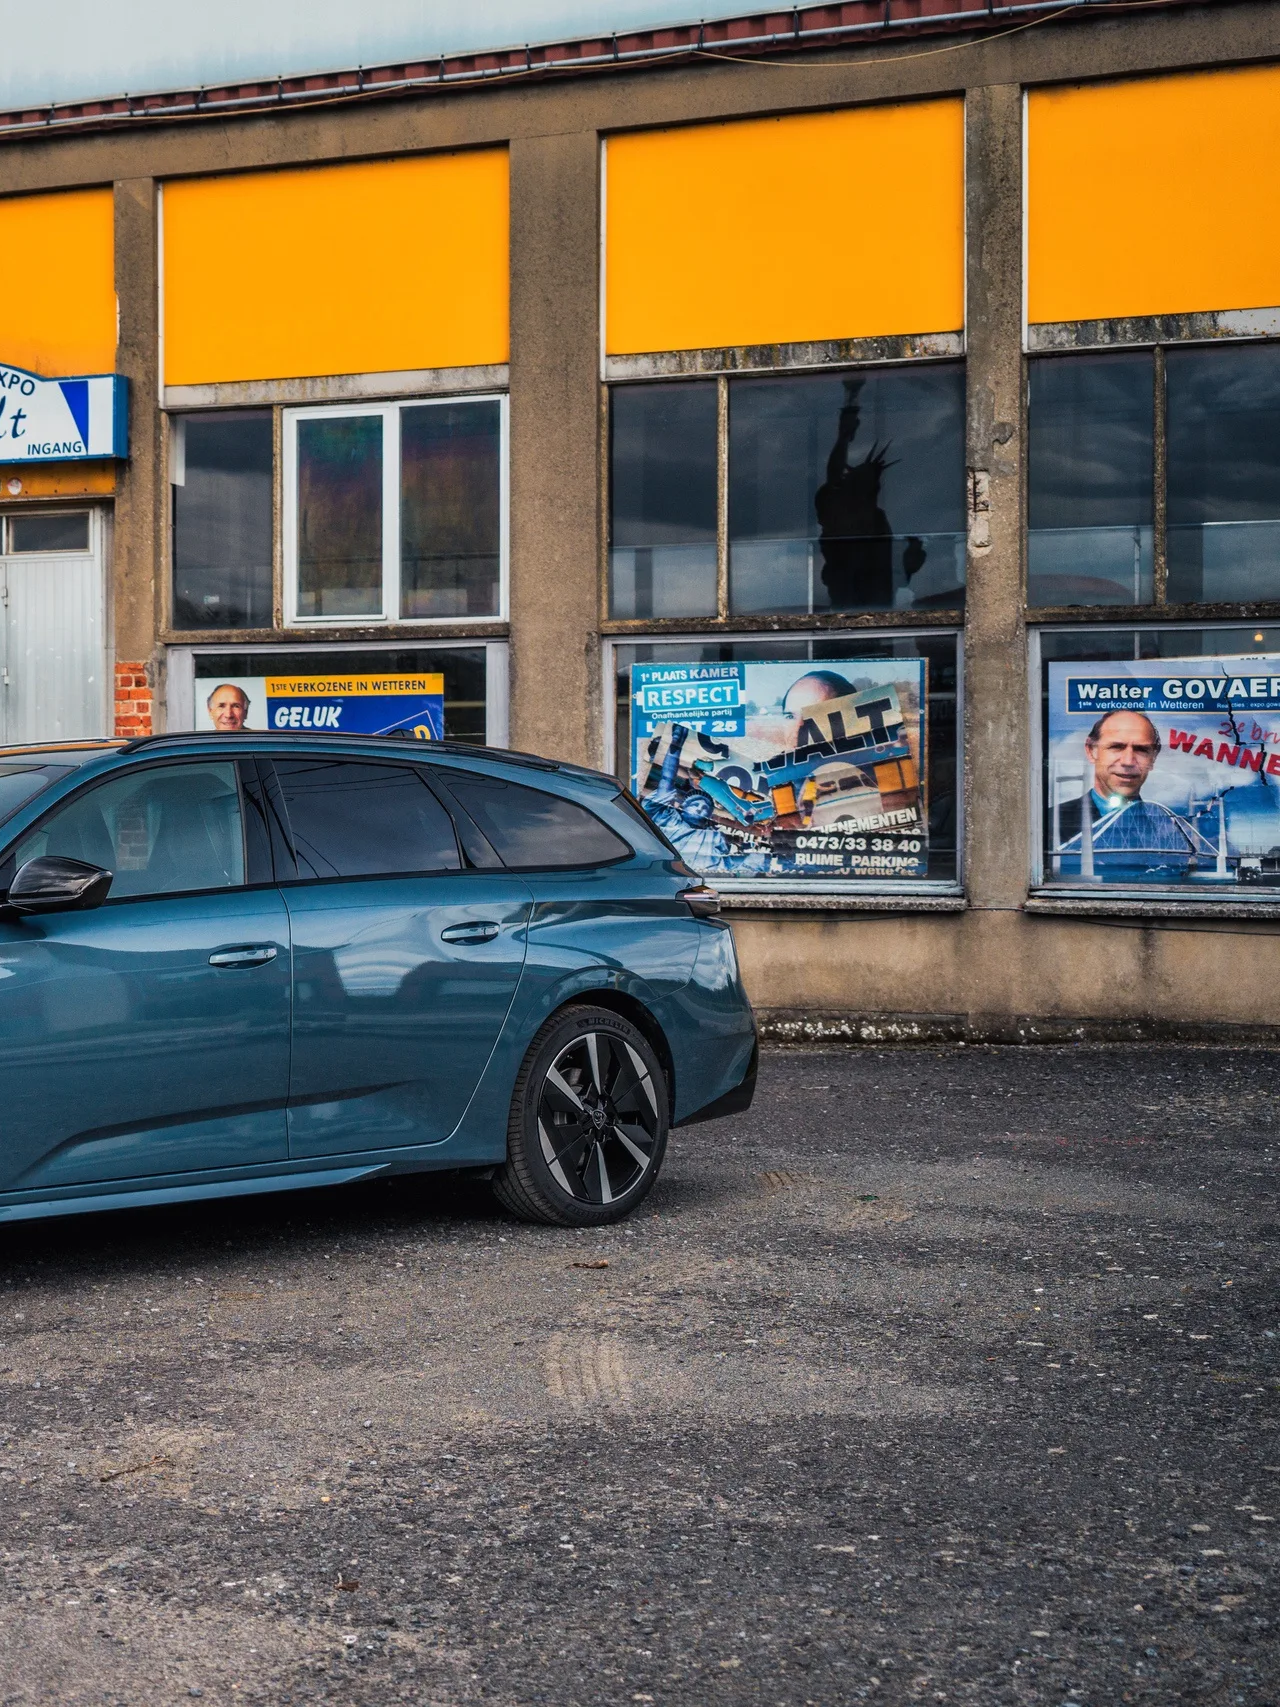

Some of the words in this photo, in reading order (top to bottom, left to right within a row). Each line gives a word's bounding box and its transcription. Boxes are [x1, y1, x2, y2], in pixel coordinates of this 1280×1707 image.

[27, 441, 83, 455] INGANG
[652, 669, 687, 682] PLAATS
[689, 667, 739, 679] KAMER
[289, 681, 353, 692] VERKOZENE
[356, 681, 368, 691] IN
[371, 680, 426, 691] WETTEREN
[1077, 683, 1153, 699] Walter
[647, 686, 734, 707] RESPECT
[1096, 701, 1145, 709] verkozene
[1160, 700, 1204, 709] Wetteren
[274, 706, 342, 728] GELUK
[652, 711, 709, 720] Onafhankelijke
[711, 709, 733, 718] partij
[646, 720, 706, 733] LST
[711, 720, 738, 733] 25
[1169, 728, 1280, 777] WANNE
[796, 835, 867, 850] 0473/33
[871, 838, 894, 851] 38
[897, 839, 921, 852] 40
[795, 853, 844, 866] RUIME
